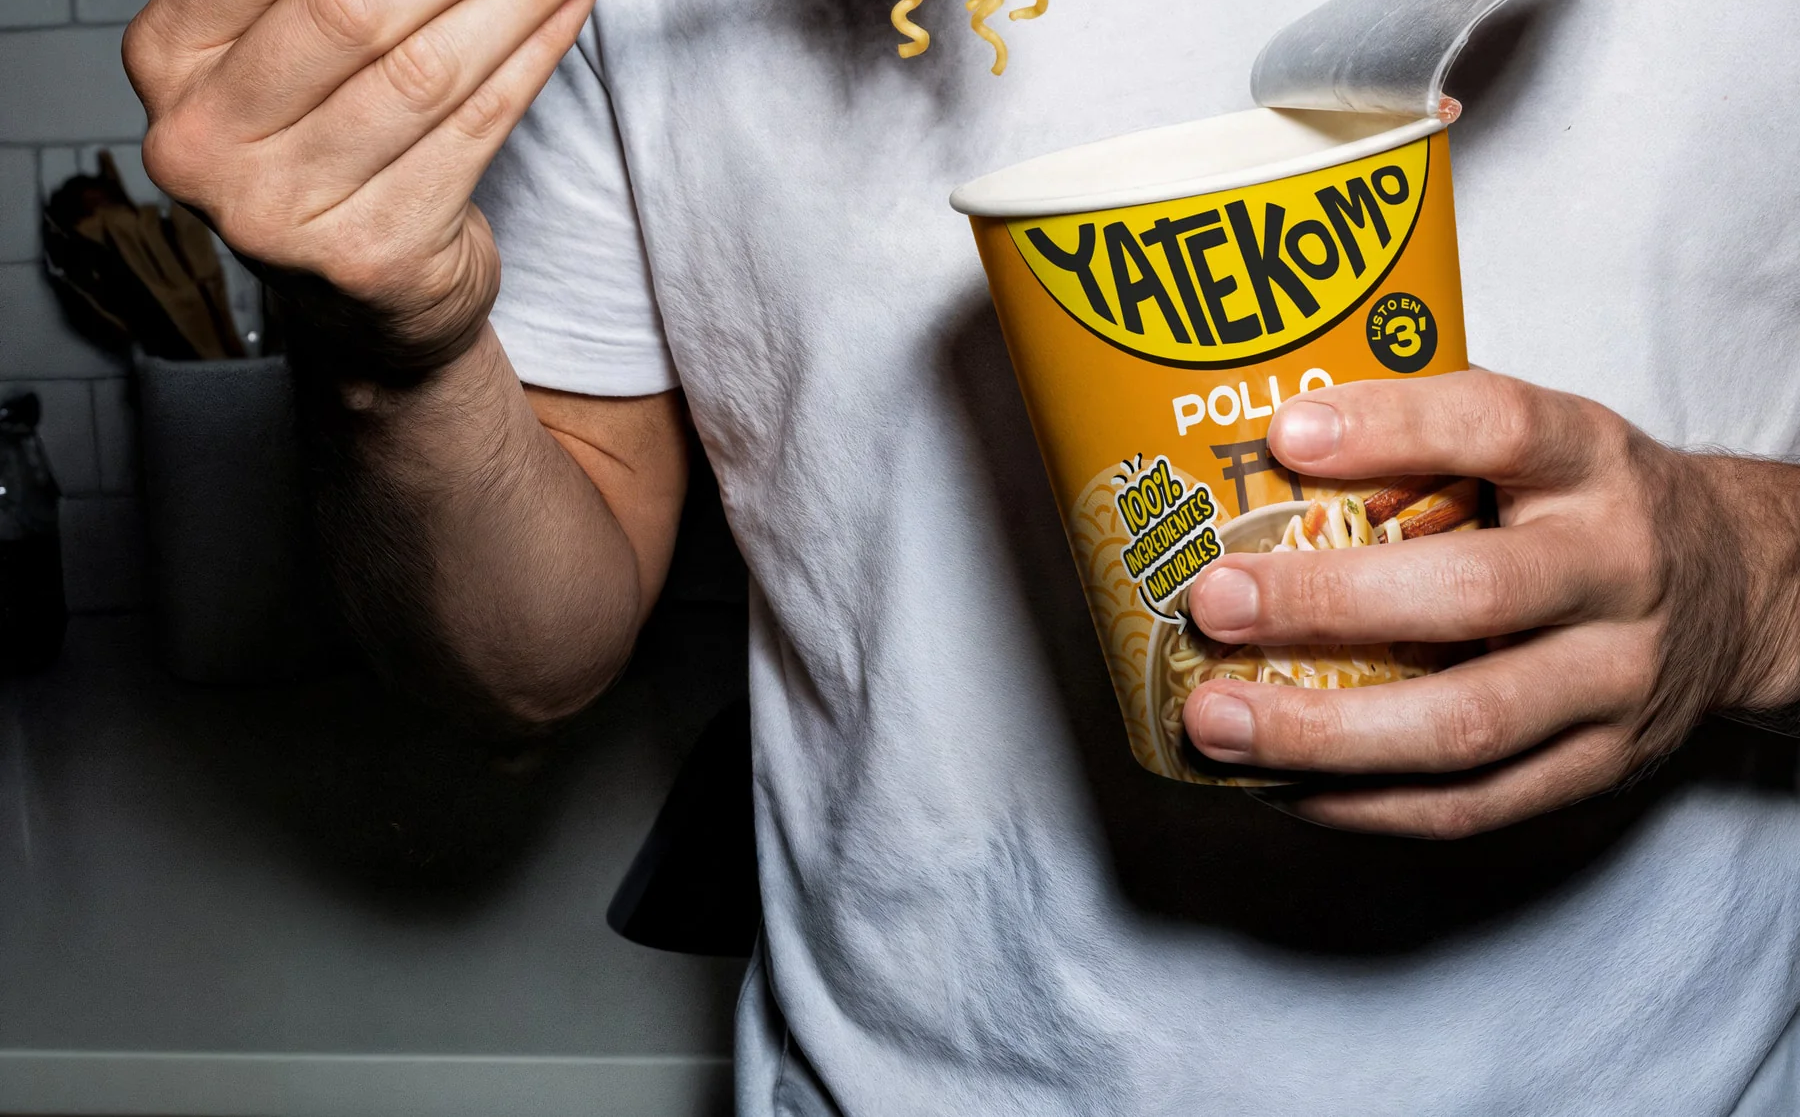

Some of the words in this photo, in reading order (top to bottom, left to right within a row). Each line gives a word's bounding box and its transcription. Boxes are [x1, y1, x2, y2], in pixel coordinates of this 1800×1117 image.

[1025, 164, 1410, 346] YATEKOMO
[1371, 299, 1397, 341] LISTO
[1401, 298, 1421, 314] EN
[1119, 461, 1182, 534] 100%
[1124, 488, 1214, 577] INGREDIENTES
[1146, 528, 1220, 602] NATURALES
